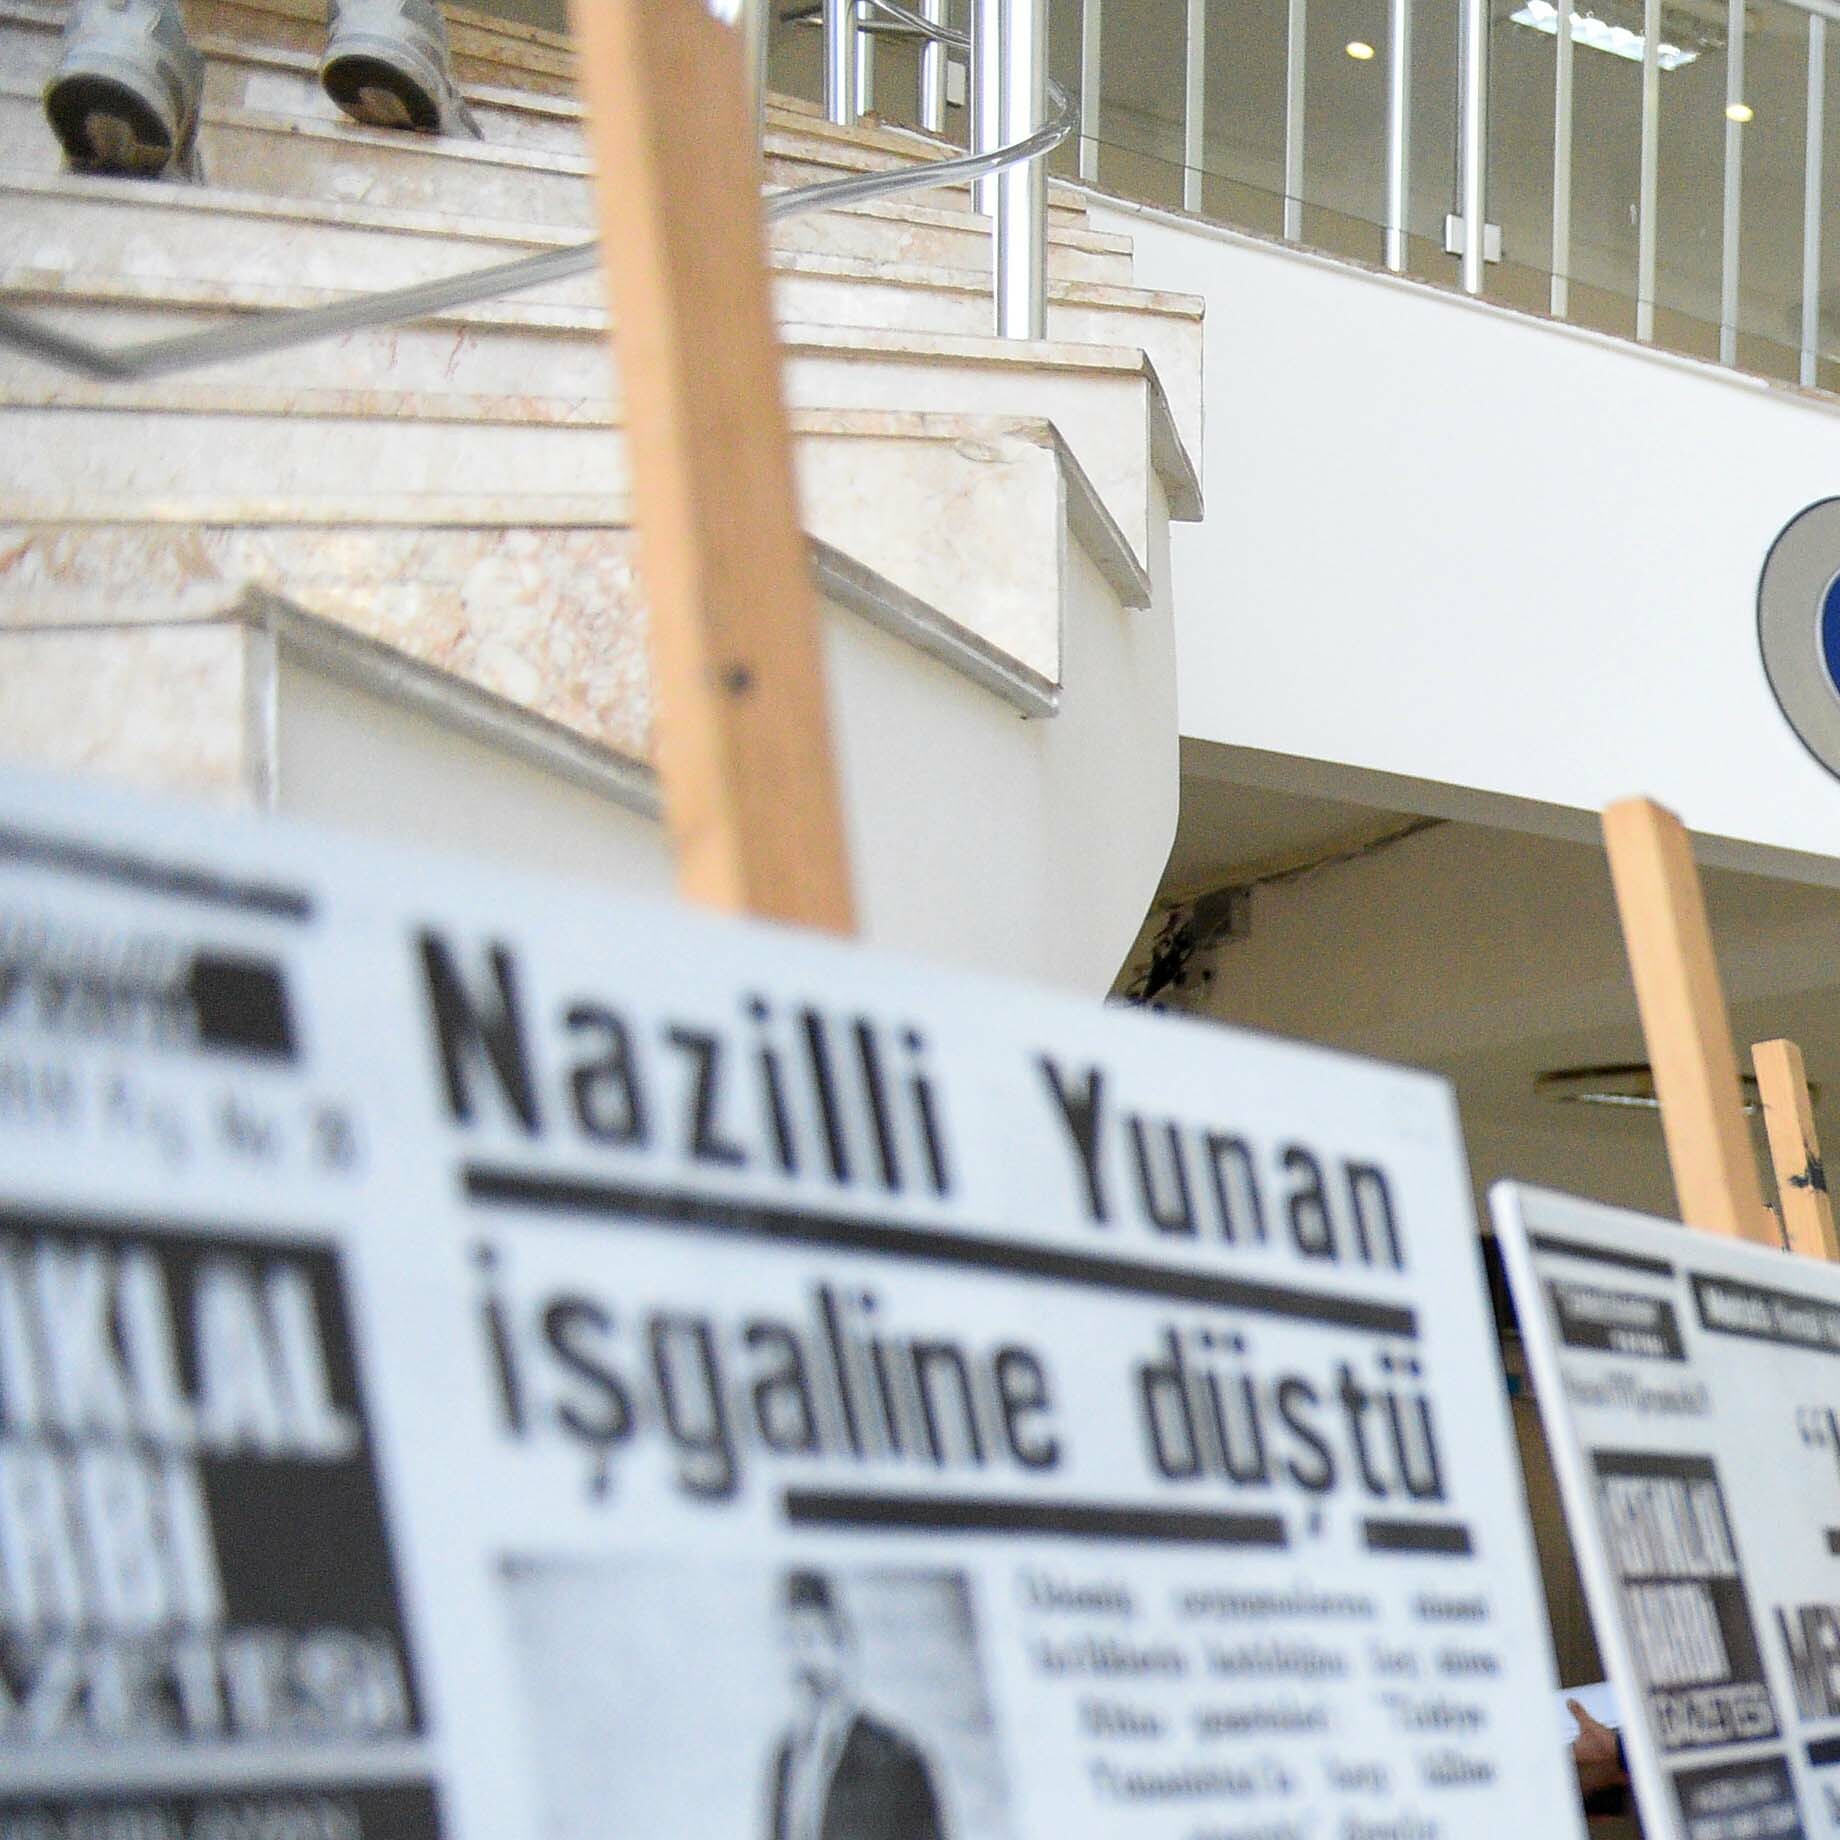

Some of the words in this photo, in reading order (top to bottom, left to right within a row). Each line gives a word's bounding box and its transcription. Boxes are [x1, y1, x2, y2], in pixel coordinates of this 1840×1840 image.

[416, 924, 952, 1198] Nazilli
[1032, 1050, 1408, 1274] Yunan
[476, 1240, 1064, 1504] işgaline
[1132, 1320, 1446, 1540] düştü
